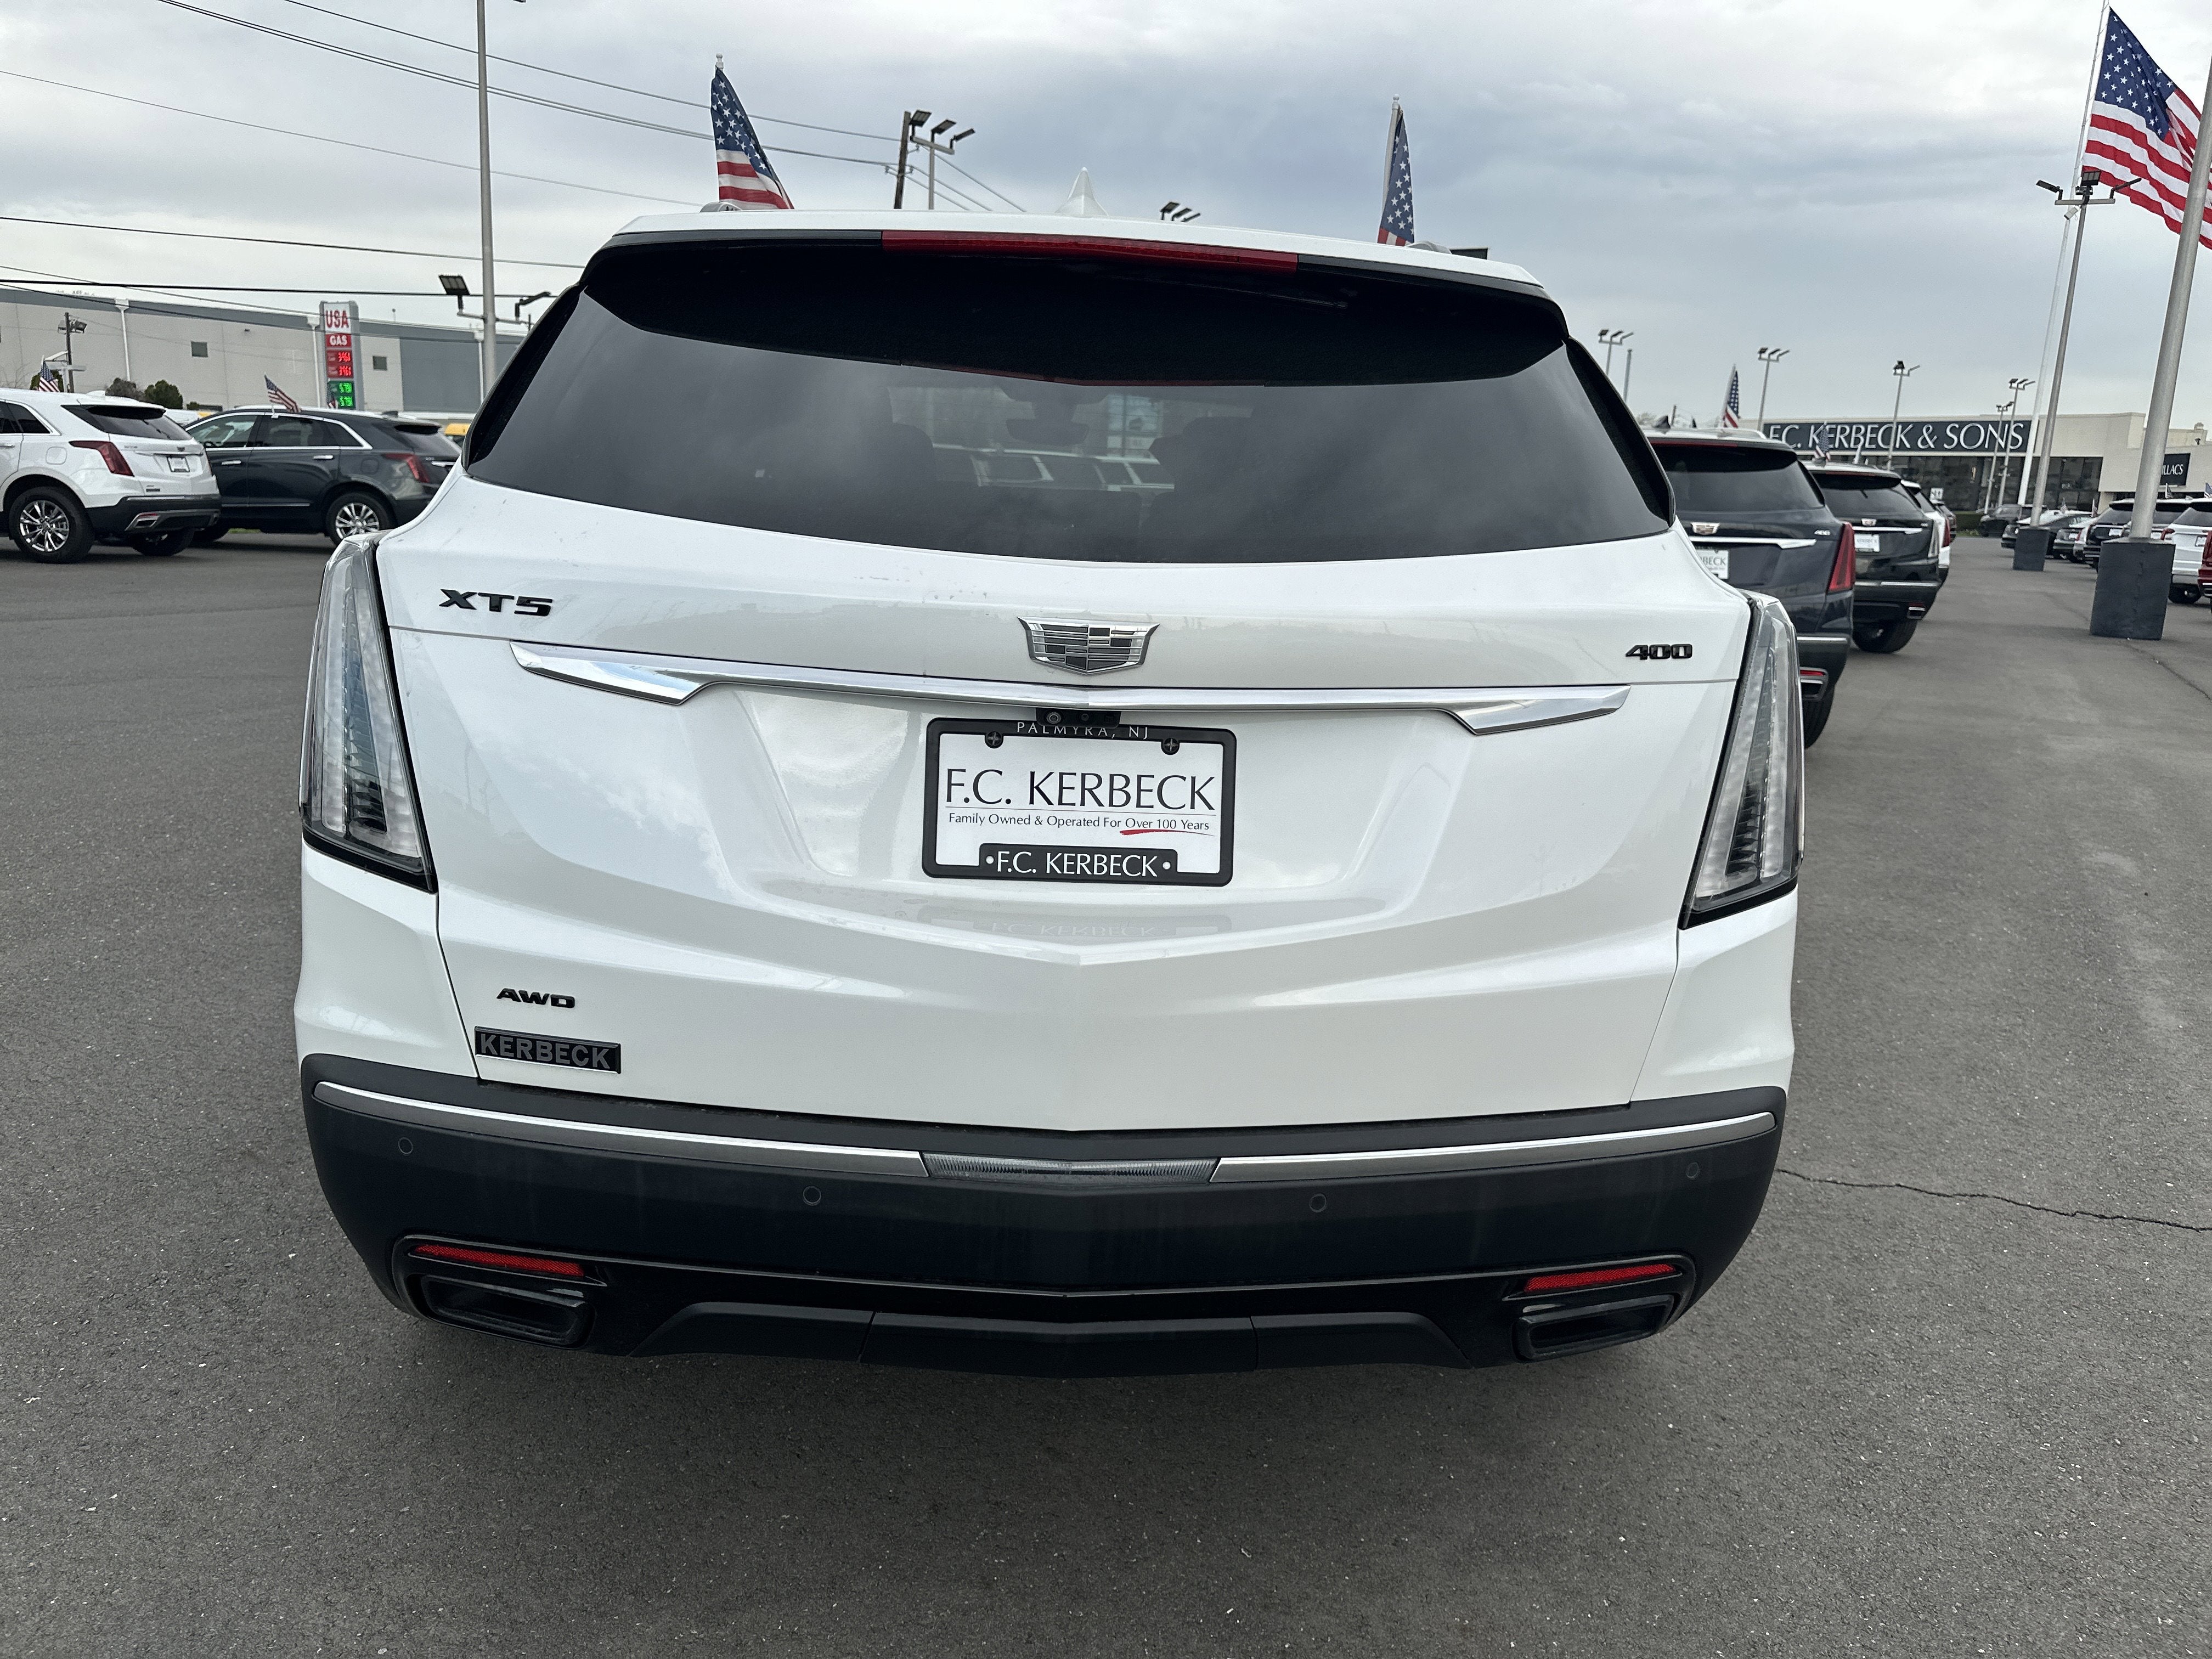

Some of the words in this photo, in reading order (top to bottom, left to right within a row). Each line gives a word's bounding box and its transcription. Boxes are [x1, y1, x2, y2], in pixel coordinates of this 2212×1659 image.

[325, 310, 349, 328] USA
[330, 335, 348, 346] GAS
[1769, 424, 1802, 449] FC.
[1808, 424, 1914, 449] KERBECK
[1917, 424, 1938, 449] &
[1944, 422, 2024, 449] SONS
[1701, 555, 1726, 566] BECK
[439, 589, 553, 617] XT5
[1626, 644, 1693, 660] 400
[1128, 726, 1148, 740] NJ
[946, 768, 1012, 805] F.C.
[1029, 771, 1215, 810] KERBECK
[949, 812, 986, 826] Family
[989, 813, 1031, 825] Owned
[1034, 815, 1043, 826] &
[1047, 815, 1100, 828] Operated
[1103, 817, 1122, 828] For
[1125, 817, 1153, 828] Over
[1156, 819, 1177, 830] 100
[1180, 819, 1210, 831] Years
[997, 851, 1037, 874] F.C.
[1046, 852, 1158, 877] KERBECK
[496, 988, 575, 1008] AWD
[481, 1034, 611, 1069] KERBECK
